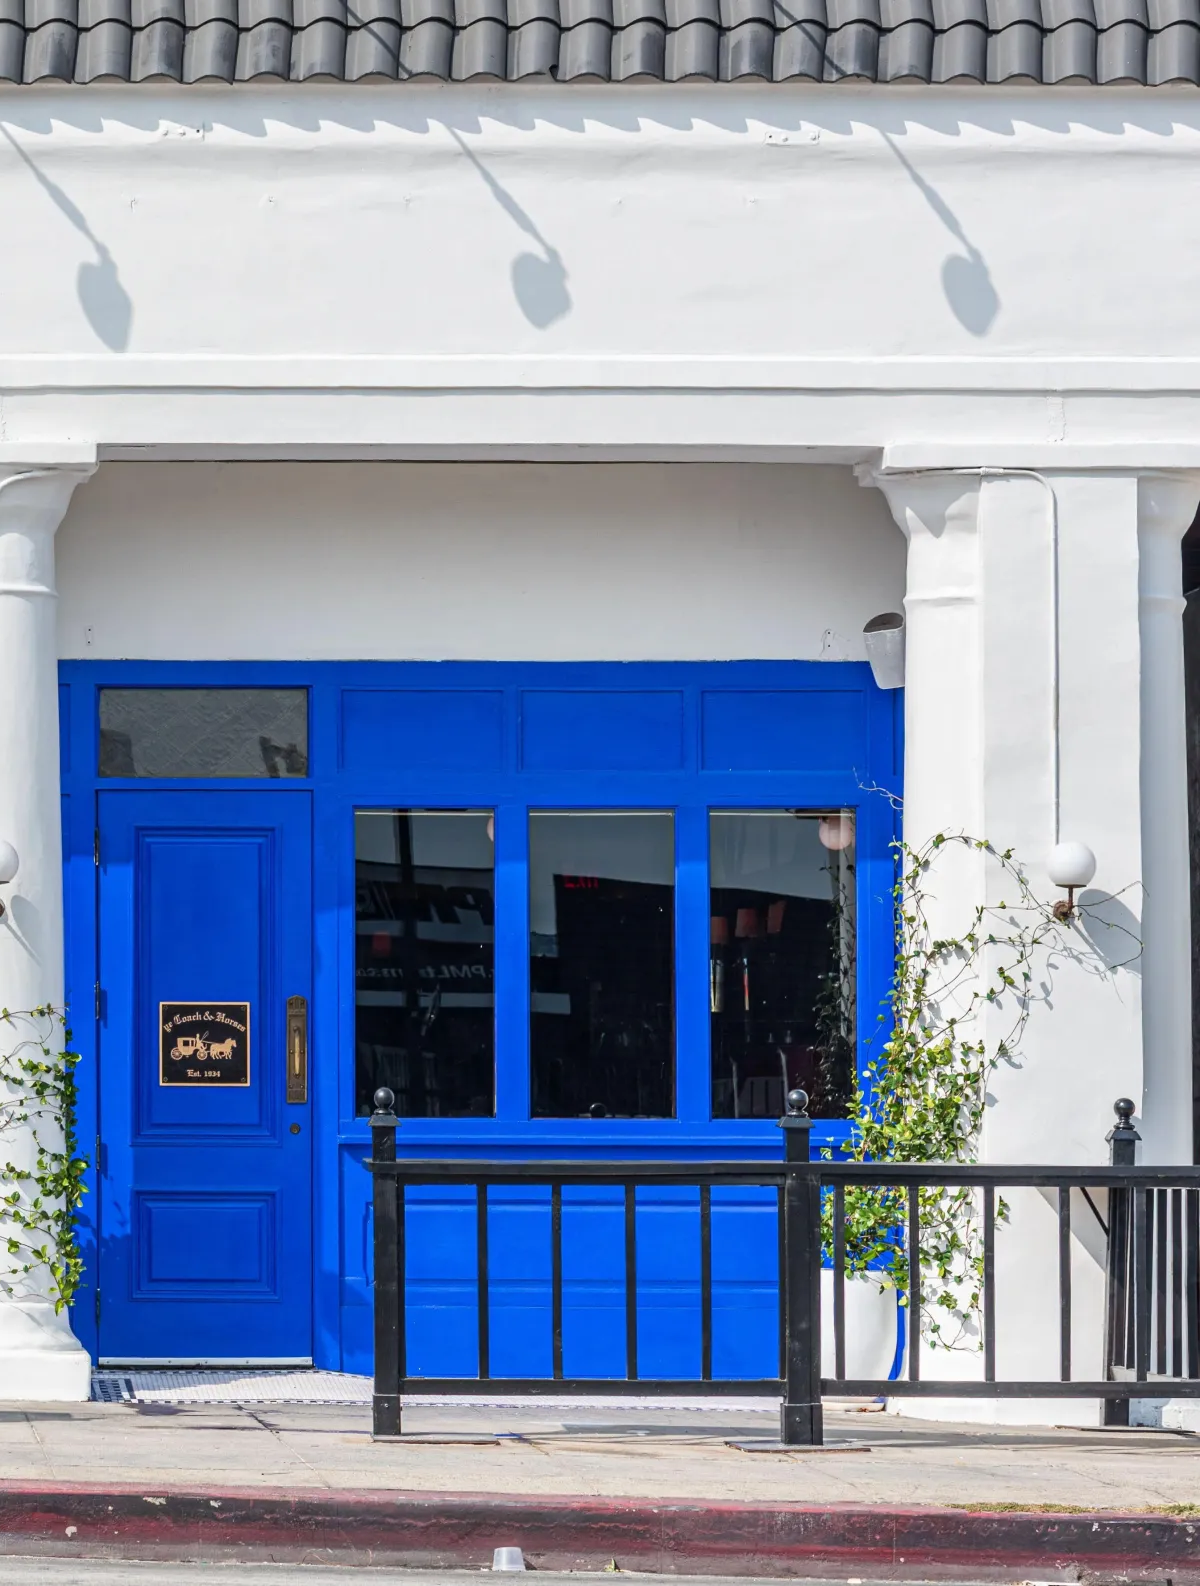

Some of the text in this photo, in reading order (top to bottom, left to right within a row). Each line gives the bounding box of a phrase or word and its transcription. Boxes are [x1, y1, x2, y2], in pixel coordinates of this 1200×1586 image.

[173, 1011, 202, 1025] Coach
[203, 1010, 215, 1021] &
[215, 1011, 246, 1032] Horses
